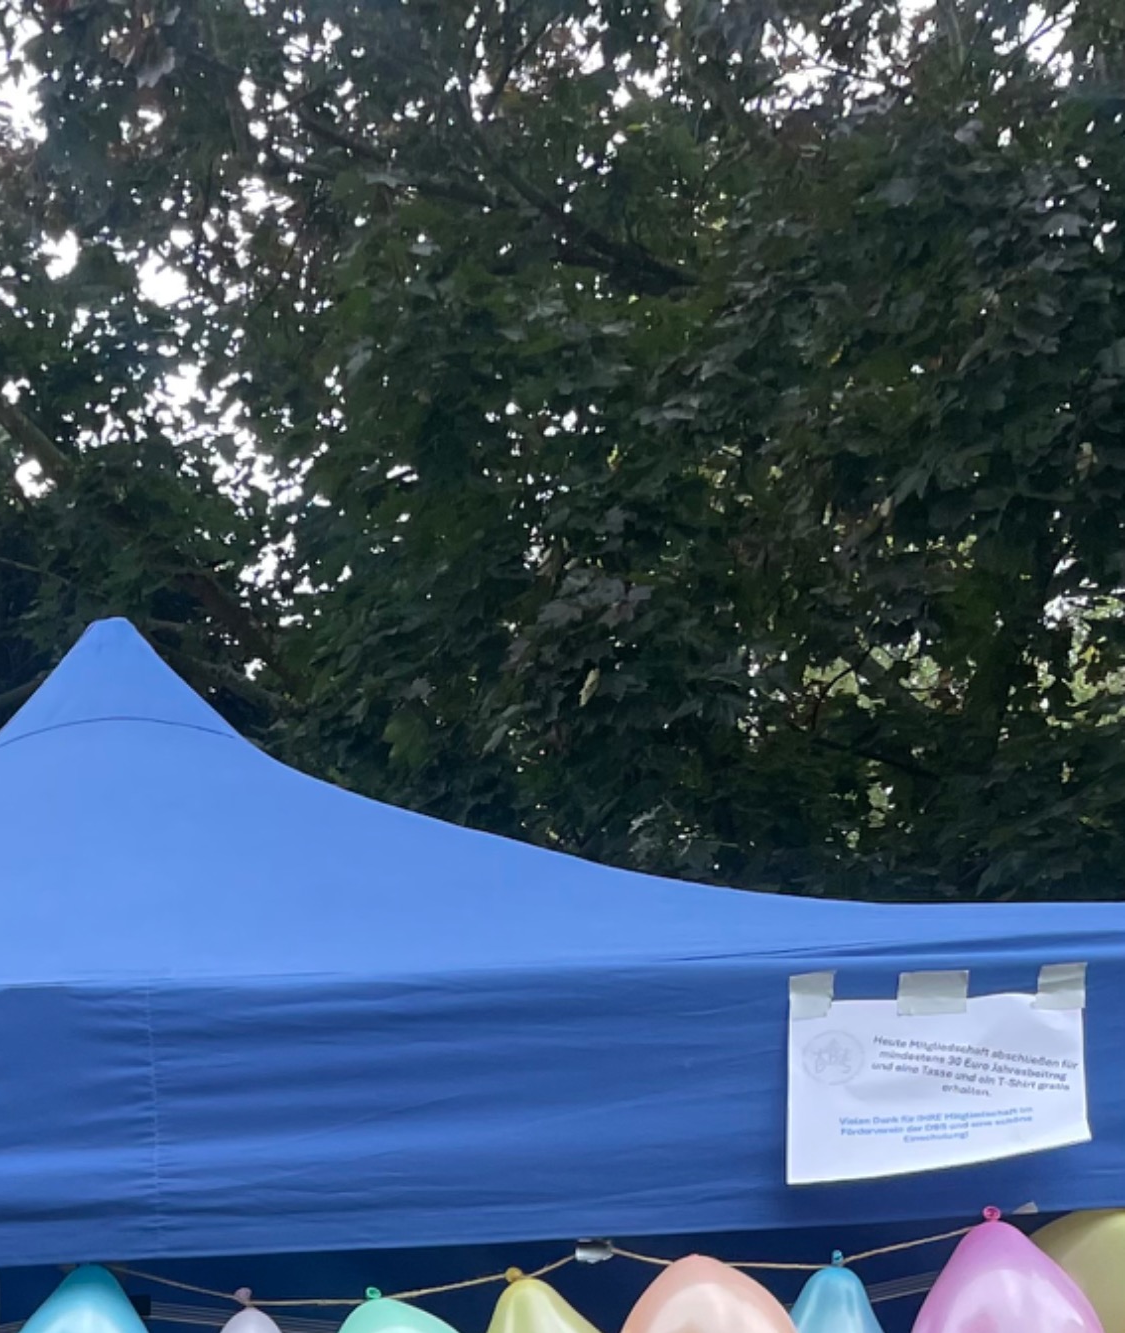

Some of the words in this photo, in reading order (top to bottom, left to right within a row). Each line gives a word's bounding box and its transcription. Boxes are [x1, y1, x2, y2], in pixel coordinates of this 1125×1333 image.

[879, 1051, 945, 1064] mindestens
[964, 1057, 990, 1070] Euro
[991, 1063, 1067, 1082] Jahresbeitrag
[909, 1040, 990, 1057] Mitgliedschaft
[991, 1050, 1060, 1067] abschließen
[871, 1062, 894, 1071] und
[895, 1064, 919, 1074] eine
[922, 1065, 953, 1078] Tasse
[954, 1072, 977, 1082] und
[978, 1076, 996, 1085] ein
[998, 1077, 1036, 1089] T-Shirt
[839, 1116, 872, 1125] Vielen
[873, 1115, 899, 1124] Dank
